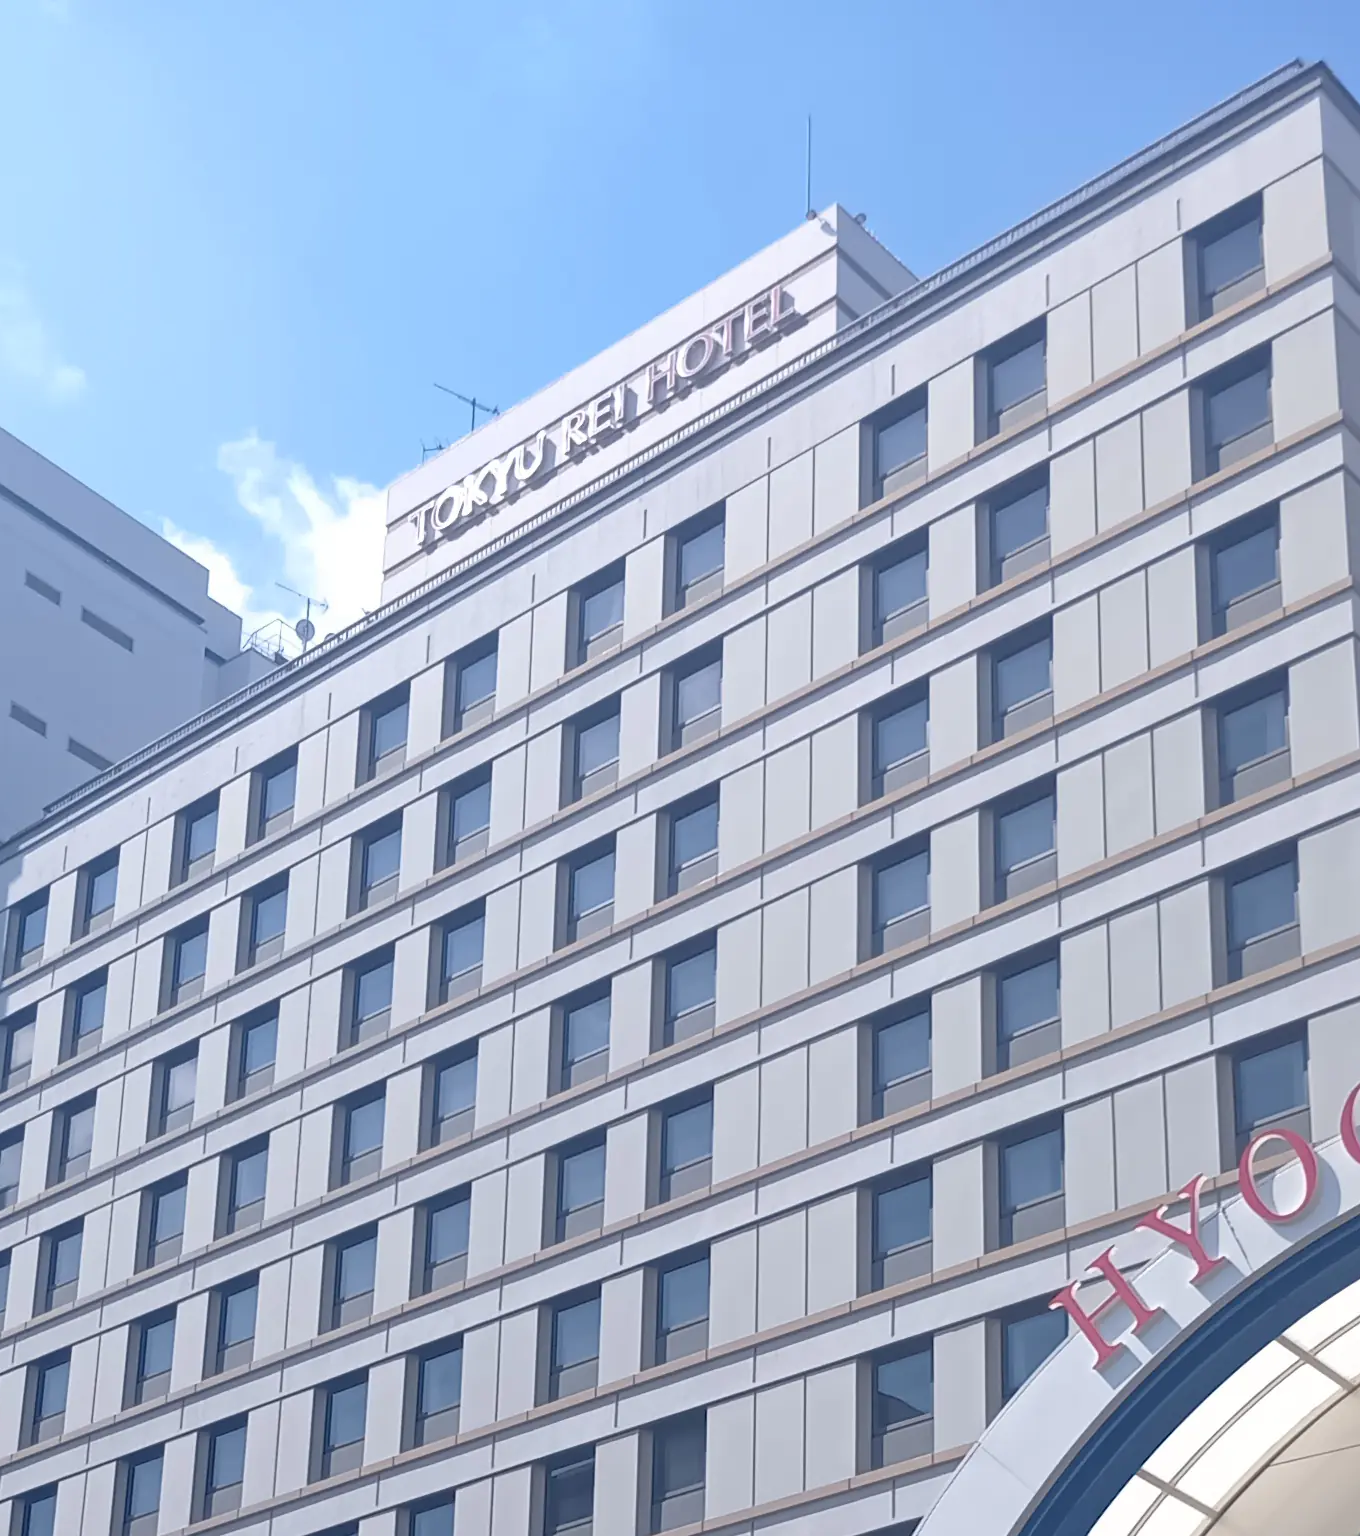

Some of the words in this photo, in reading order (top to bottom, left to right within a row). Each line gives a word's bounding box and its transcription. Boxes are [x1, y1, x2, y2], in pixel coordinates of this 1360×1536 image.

[409, 430, 547, 547] TOKYU
[561, 383, 629, 455] REI
[644, 284, 797, 403] HOTEL
